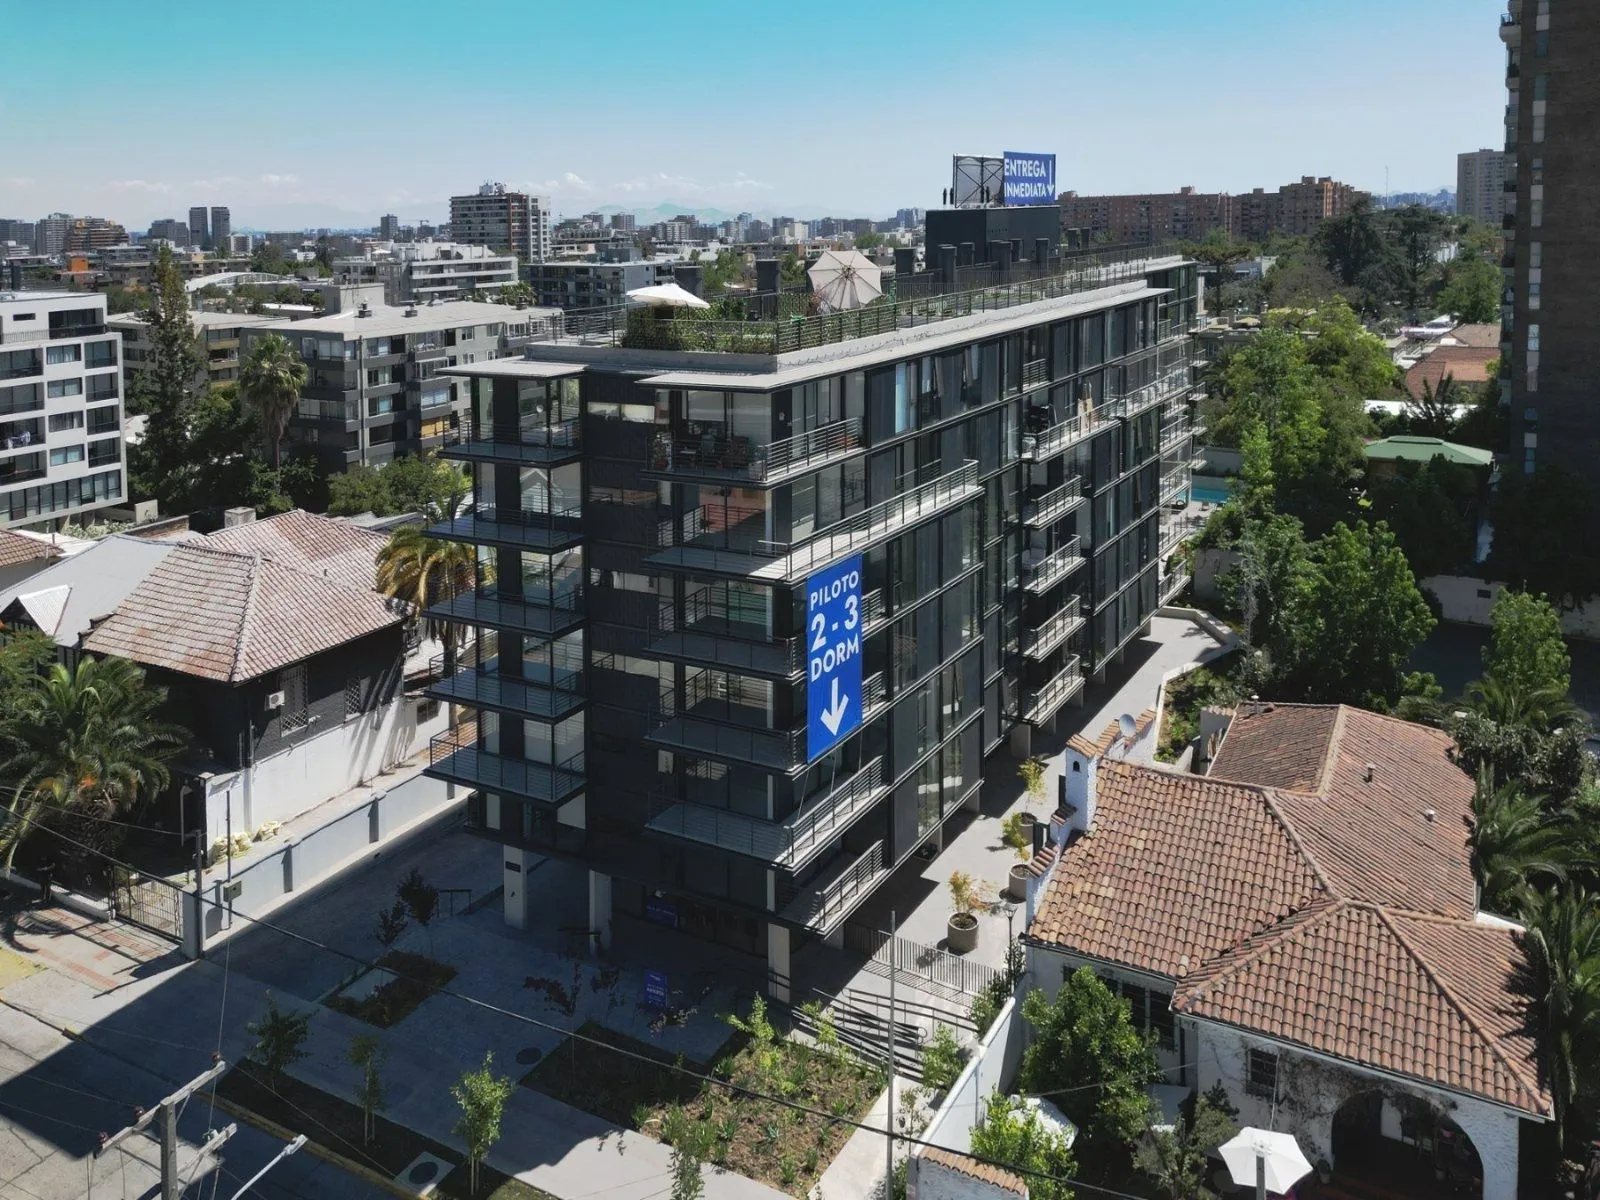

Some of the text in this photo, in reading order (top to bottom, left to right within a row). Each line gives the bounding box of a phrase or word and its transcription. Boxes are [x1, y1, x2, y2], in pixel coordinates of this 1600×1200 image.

[1004, 158, 1047, 178] ENTREGA
[1004, 182, 1047, 198] INMEDIATA
[810, 570, 859, 611] PILOTO
[810, 632, 859, 683] DORM
